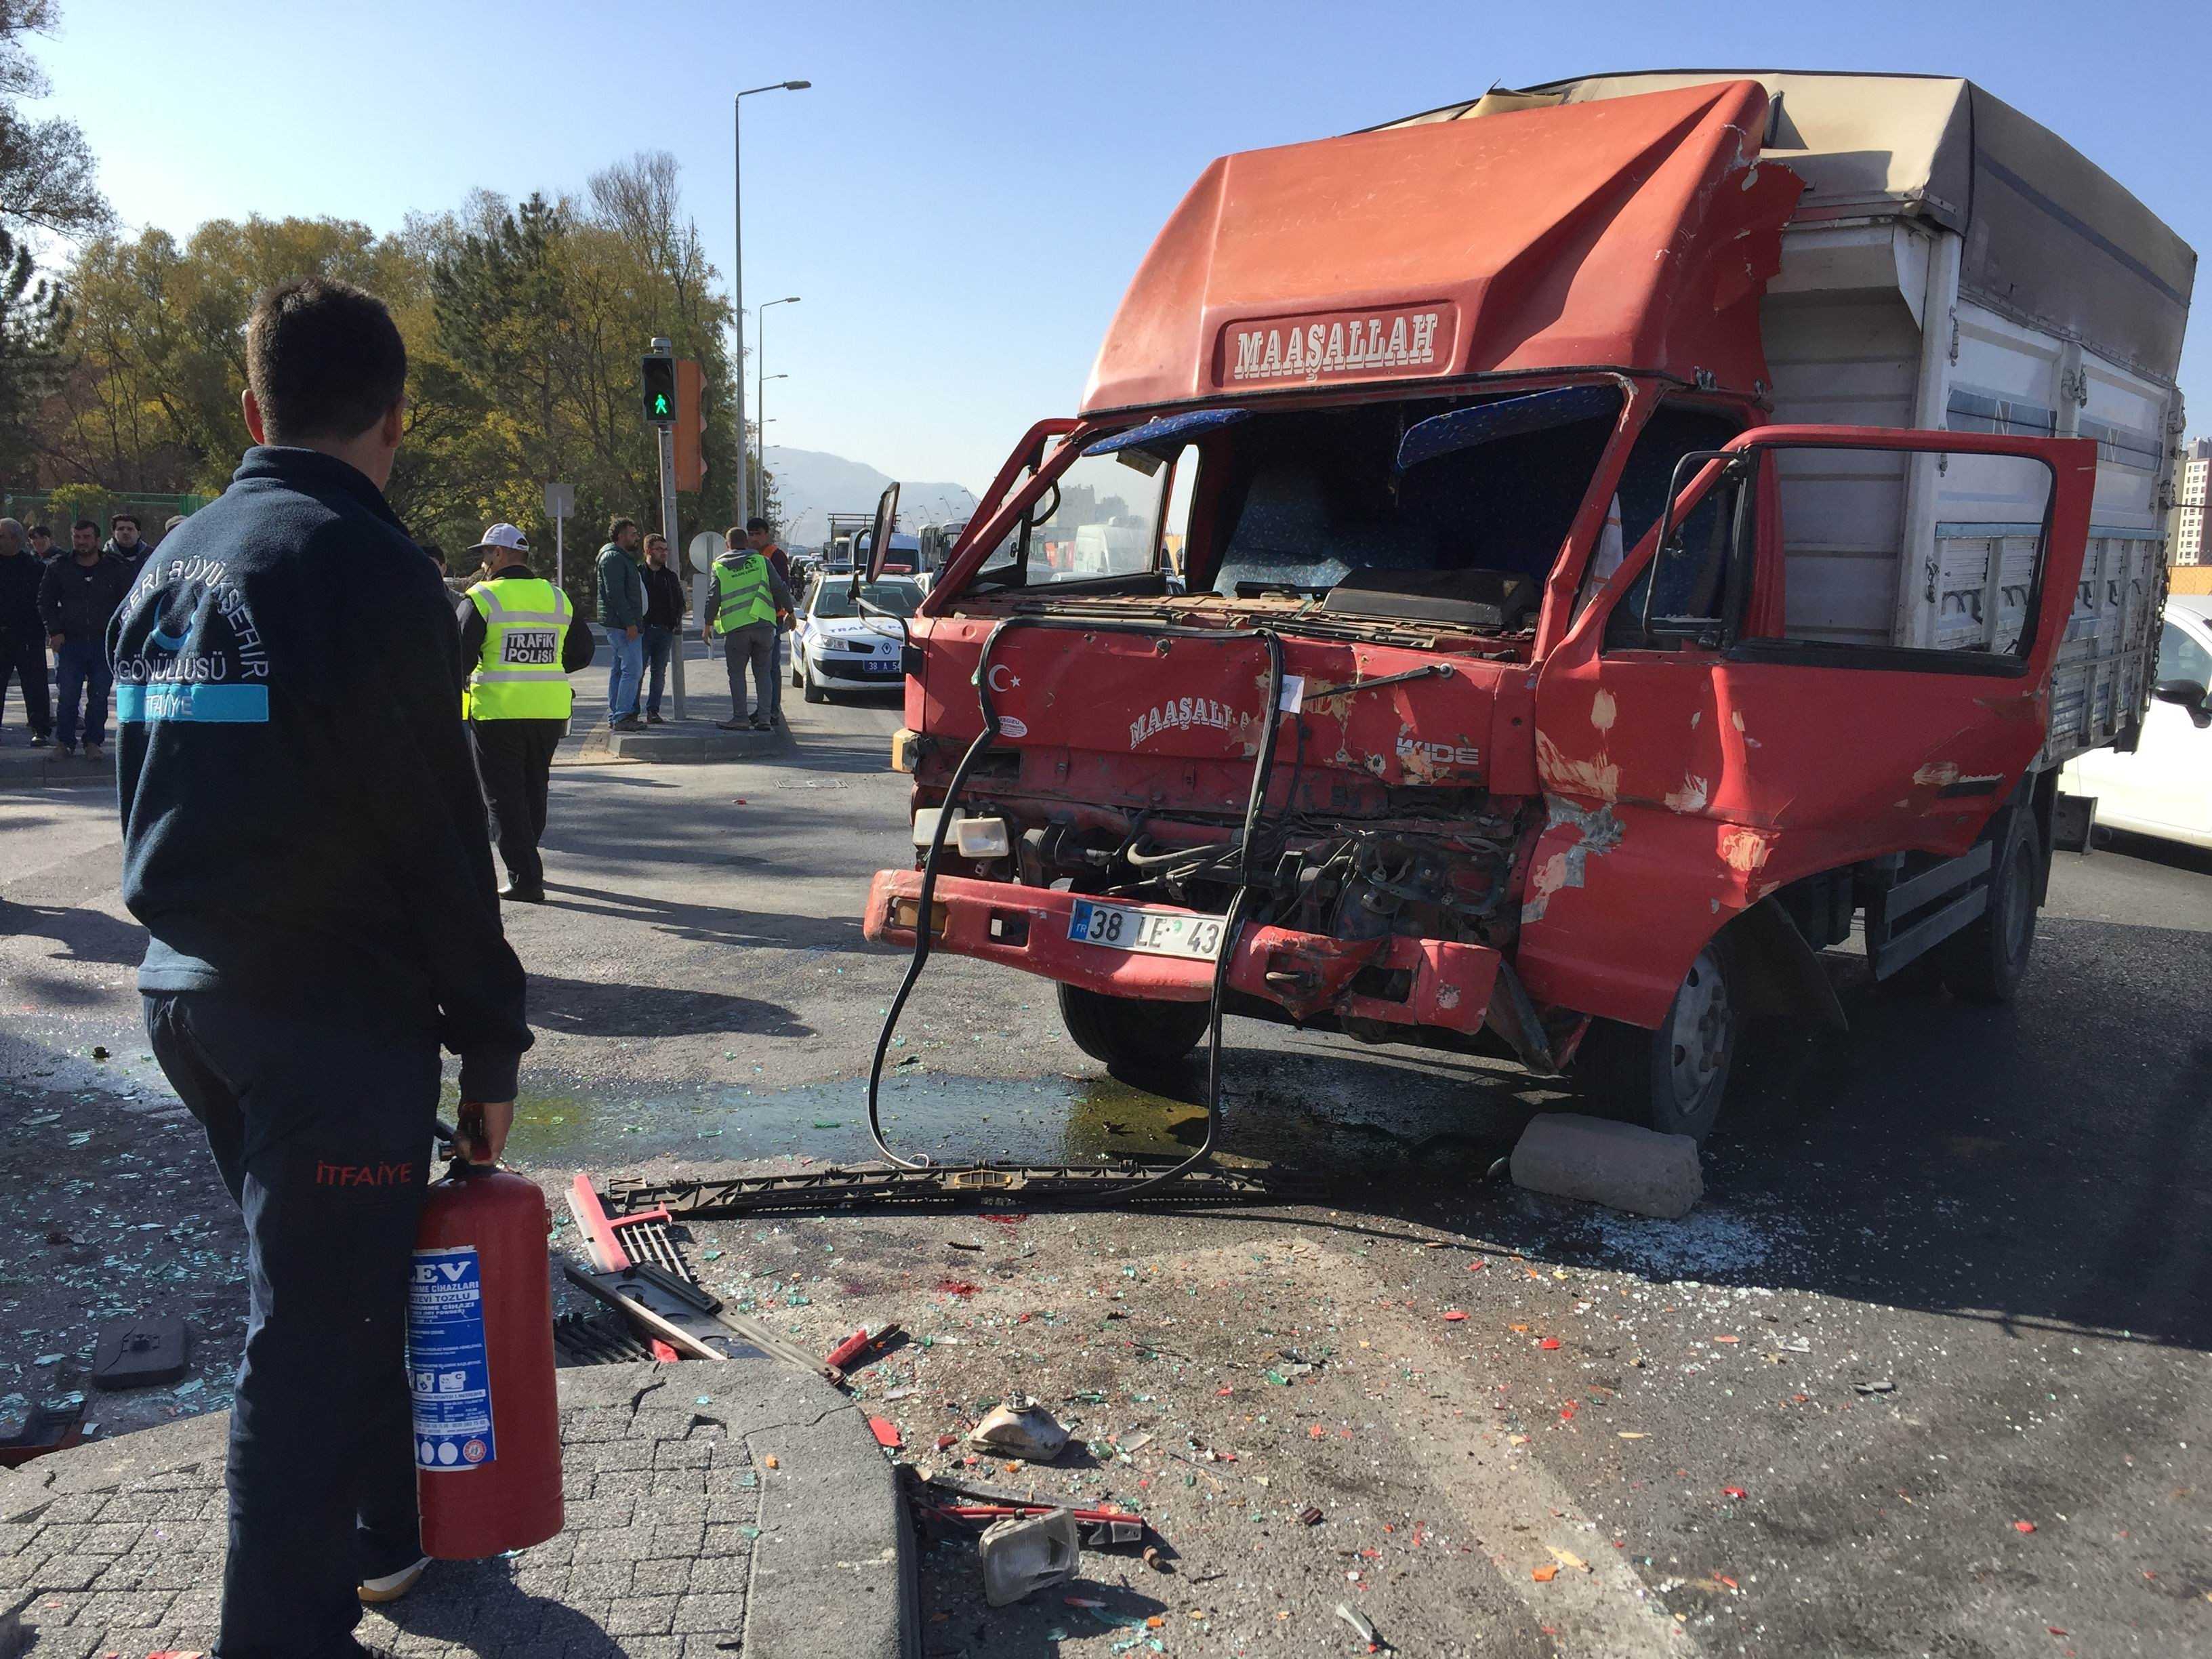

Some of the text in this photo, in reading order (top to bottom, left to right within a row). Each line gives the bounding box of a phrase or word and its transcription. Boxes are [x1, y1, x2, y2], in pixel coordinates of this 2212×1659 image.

[1234, 314, 1437, 382] MAAŞALLAH
[118, 651, 225, 680] GÖNÜLLÜSÜ
[869, 661, 878, 670] 38
[883, 661, 888, 670] A
[1090, 910, 1123, 941] 38
[1134, 916, 1167, 948] LE
[1187, 922, 1219, 954] 43
[316, 1160, 413, 1186] İTFAİYE
[409, 1261, 472, 1283] EV
[431, 1280, 479, 1293] CİHAZLARI
[434, 1292, 470, 1302] TOZLU
